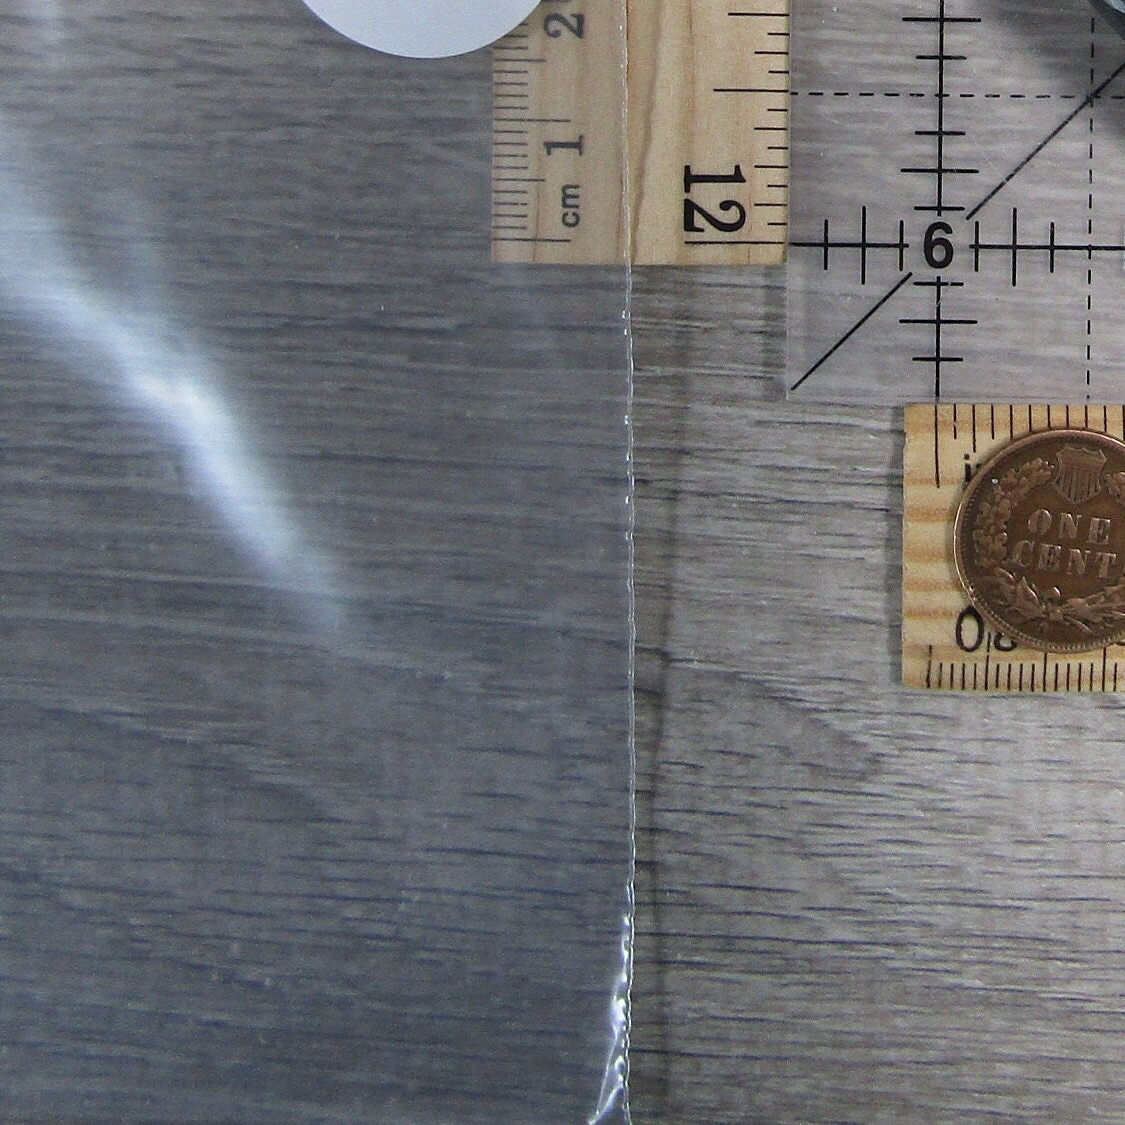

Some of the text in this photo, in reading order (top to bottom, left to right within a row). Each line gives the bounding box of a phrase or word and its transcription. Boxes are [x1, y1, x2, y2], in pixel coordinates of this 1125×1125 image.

[543, 12, 585, 39] 2
[543, 134, 585, 157] 1
[560, 183, 581, 228] cm
[683, 164, 747, 233] 12
[923, 222, 954, 269] 6
[1027, 508, 1112, 546] ONE
[1012, 539, 1117, 581] CENT
